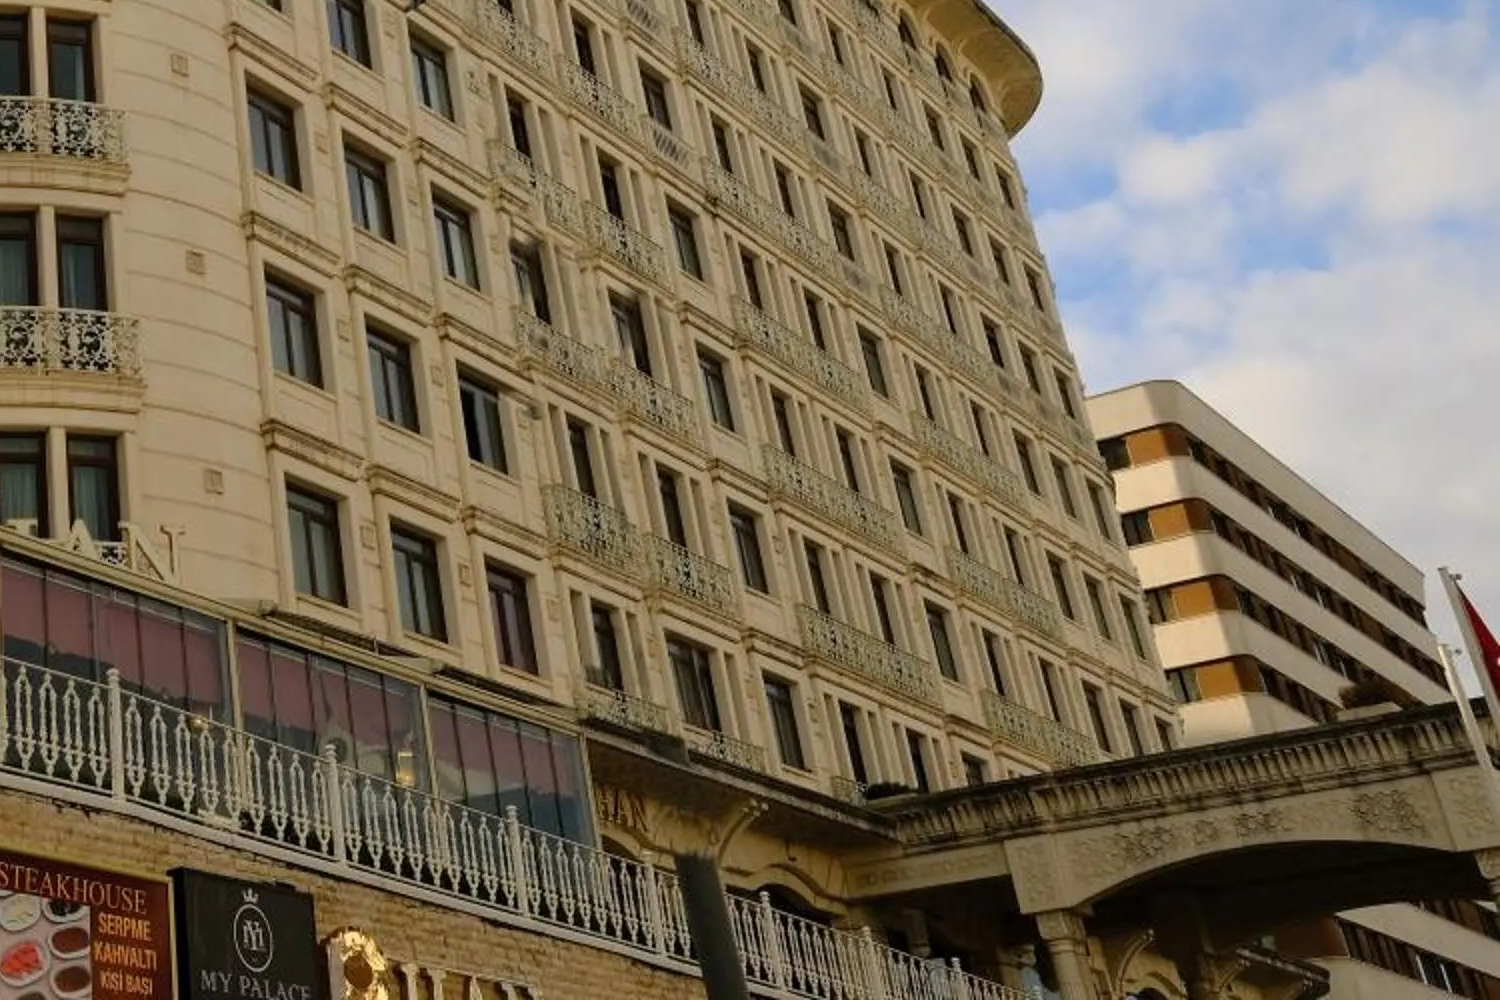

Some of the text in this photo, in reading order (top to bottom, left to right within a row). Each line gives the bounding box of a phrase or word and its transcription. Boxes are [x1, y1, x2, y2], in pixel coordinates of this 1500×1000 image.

[98, 911, 153, 942] SERPME
[94, 940, 158, 972] KAHVALTI
[200, 969, 311, 1000] MY PALACE
